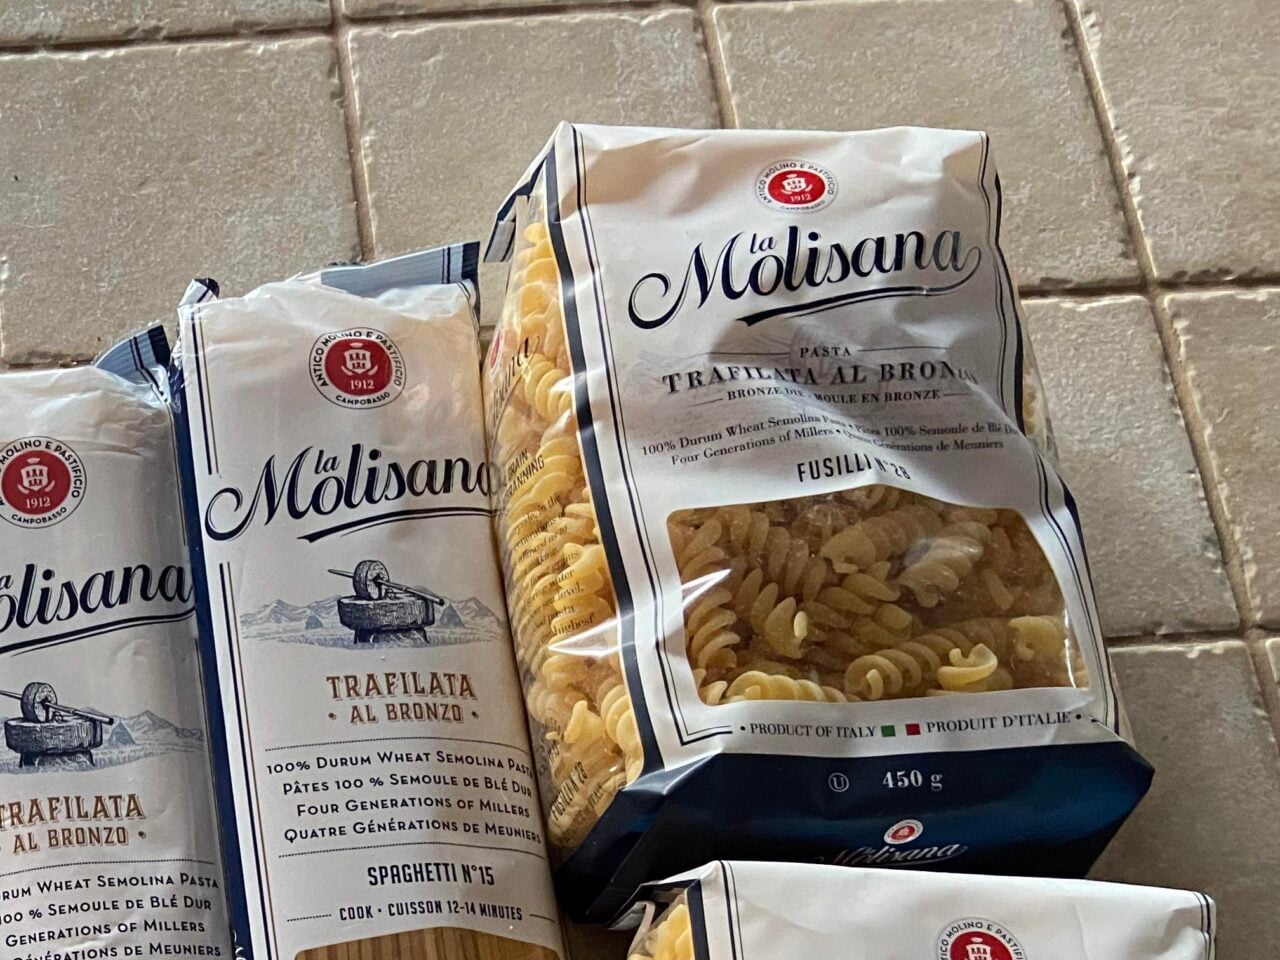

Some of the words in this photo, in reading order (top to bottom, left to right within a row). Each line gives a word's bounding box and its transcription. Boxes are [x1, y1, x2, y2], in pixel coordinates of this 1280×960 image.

[749, 232, 777, 254] la
[627, 226, 982, 330] Molisana
[314, 449, 342, 475] la
[797, 454, 872, 482] FUSILLI
[26, 496, 51, 509] 1912
[326, 671, 477, 700] TRAFILATA
[350, 705, 377, 723] AL
[385, 703, 464, 722] BRONZO
[926, 717, 998, 734] PRODUIT
[1002, 711, 1072, 729] D'ITALIE
[751, 723, 812, 738] PRODUCT
[815, 724, 832, 738] OF
[837, 724, 877, 738] ITALY
[882, 769, 923, 789] 450
[930, 773, 943, 792] g
[457, 798, 475, 811] OF
[13, 833, 39, 855] AL
[48, 827, 129, 849] BRONZO
[367, 862, 457, 886] SPAGHETTI
[117, 922, 138, 934] OF
